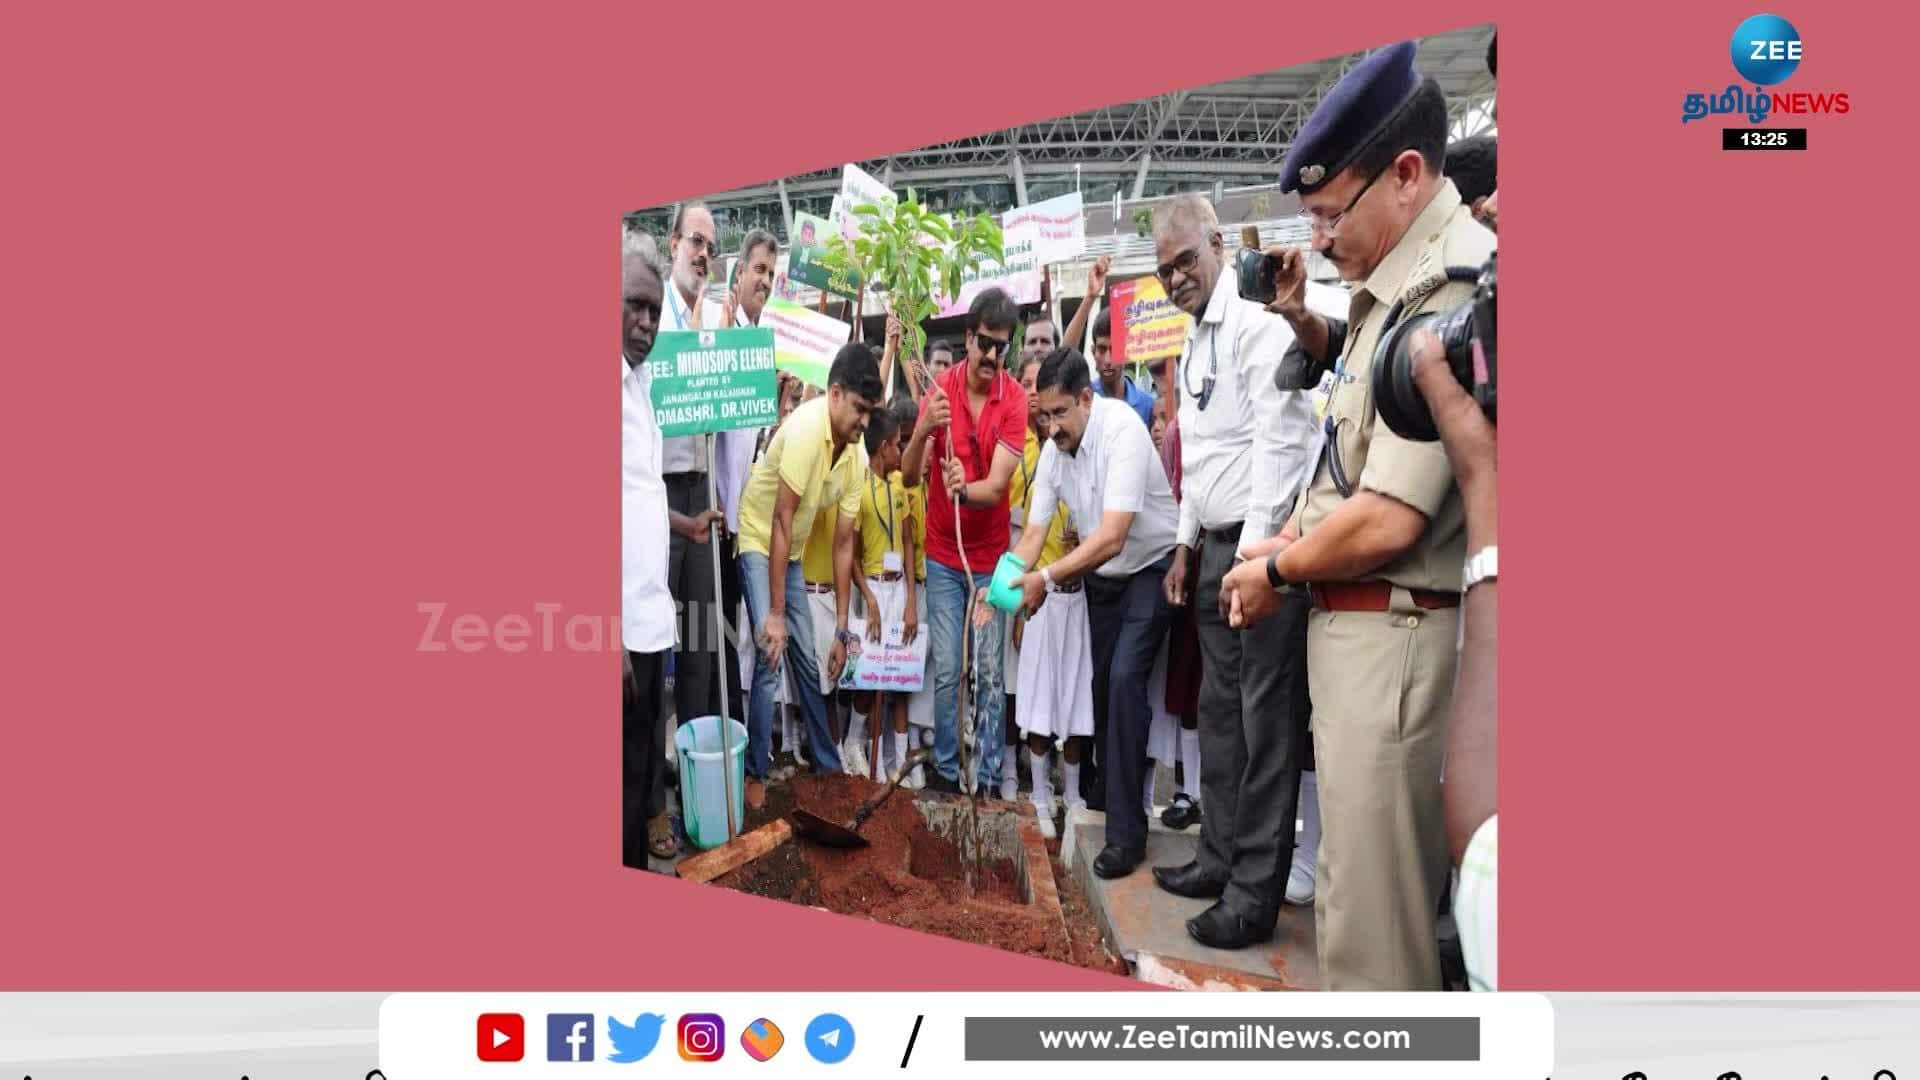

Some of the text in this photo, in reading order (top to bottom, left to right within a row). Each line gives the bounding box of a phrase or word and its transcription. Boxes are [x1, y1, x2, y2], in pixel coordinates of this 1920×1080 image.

[645, 360, 674, 378] REE:
[677, 349, 738, 376] MIMOSOPS
[656, 404, 717, 426] DMASHRI.
